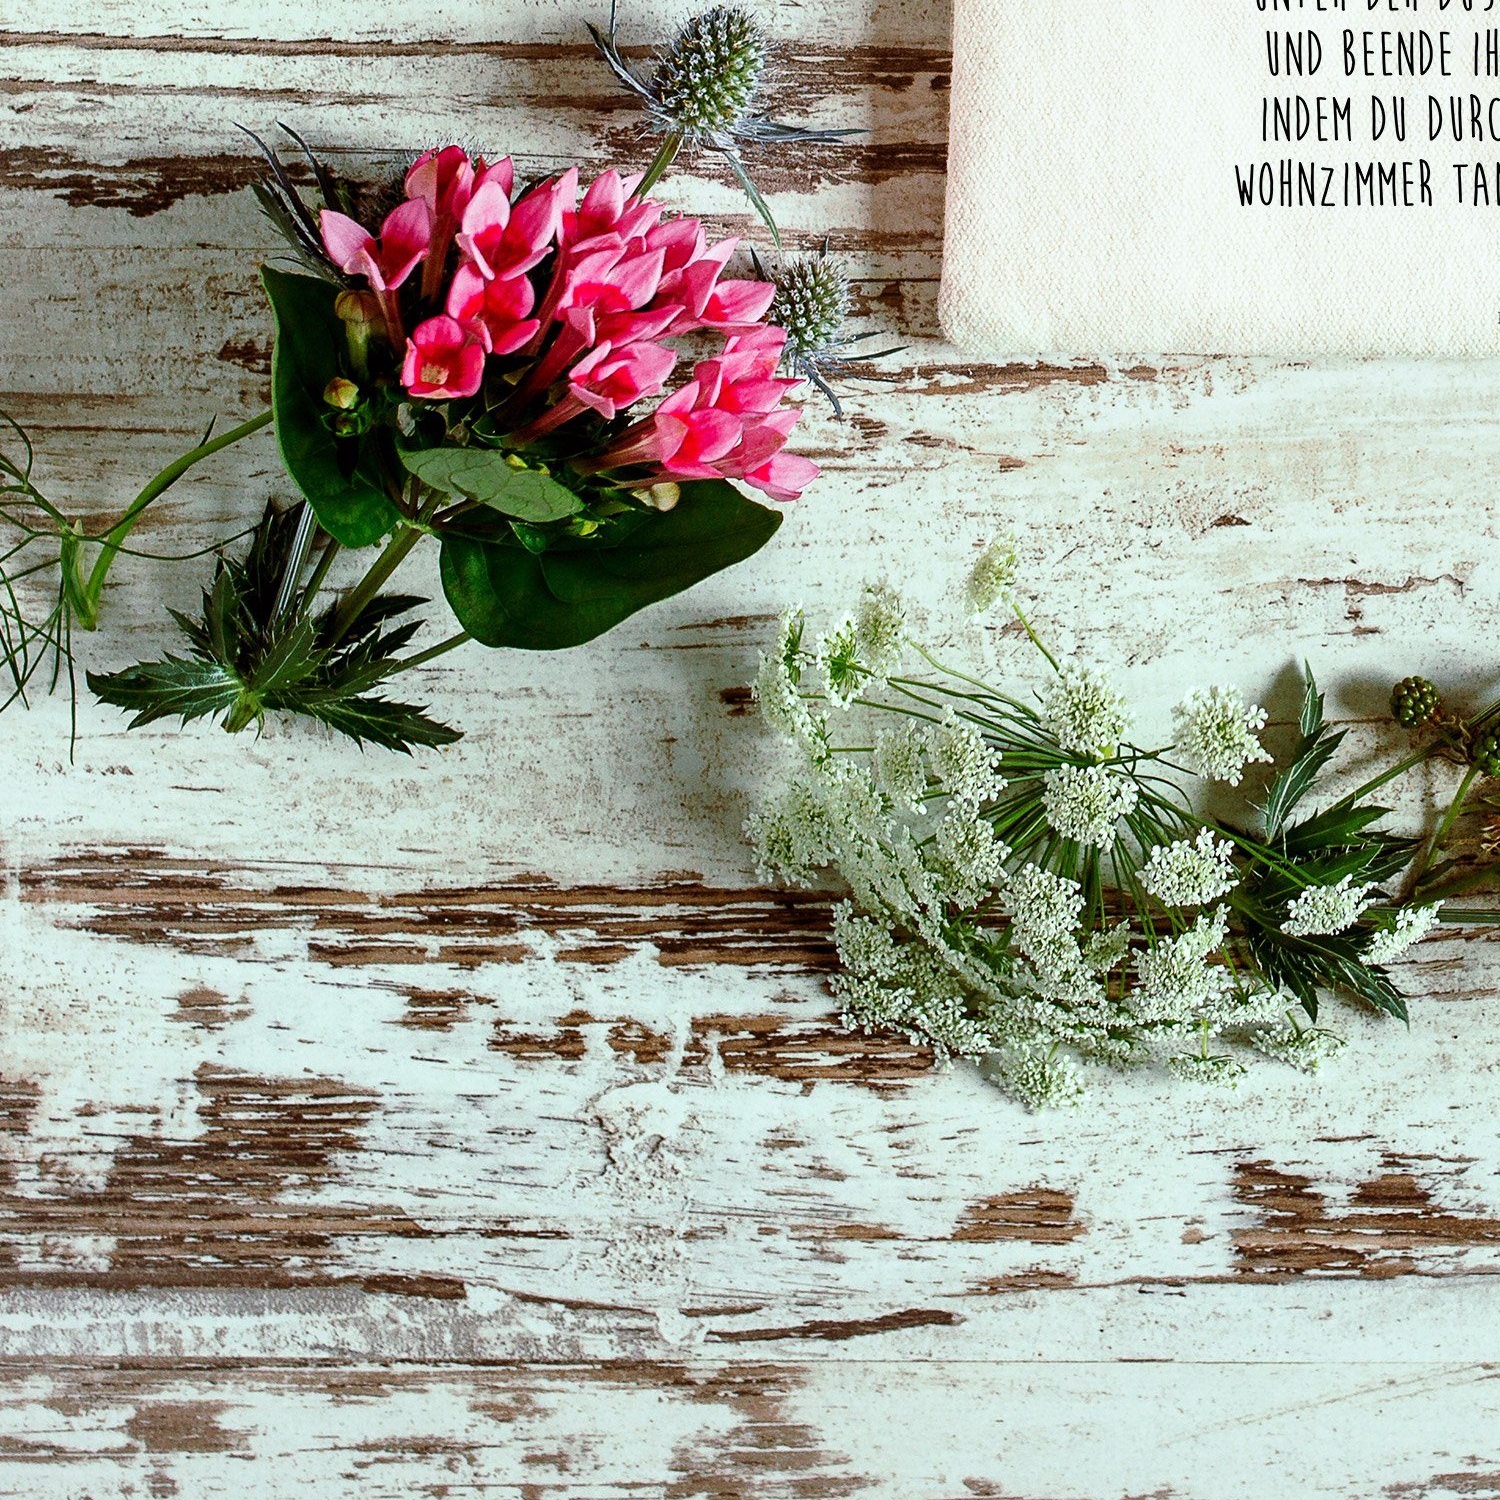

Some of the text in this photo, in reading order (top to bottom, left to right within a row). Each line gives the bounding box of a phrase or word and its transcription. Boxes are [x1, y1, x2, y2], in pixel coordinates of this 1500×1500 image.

[1265, 29, 1323, 77] UND
[1342, 28, 1452, 77] BEENDE
[1261, 94, 1352, 142] INDEM
[1371, 94, 1407, 142] DU
[1234, 158, 1433, 208] WOHNZIMMER
